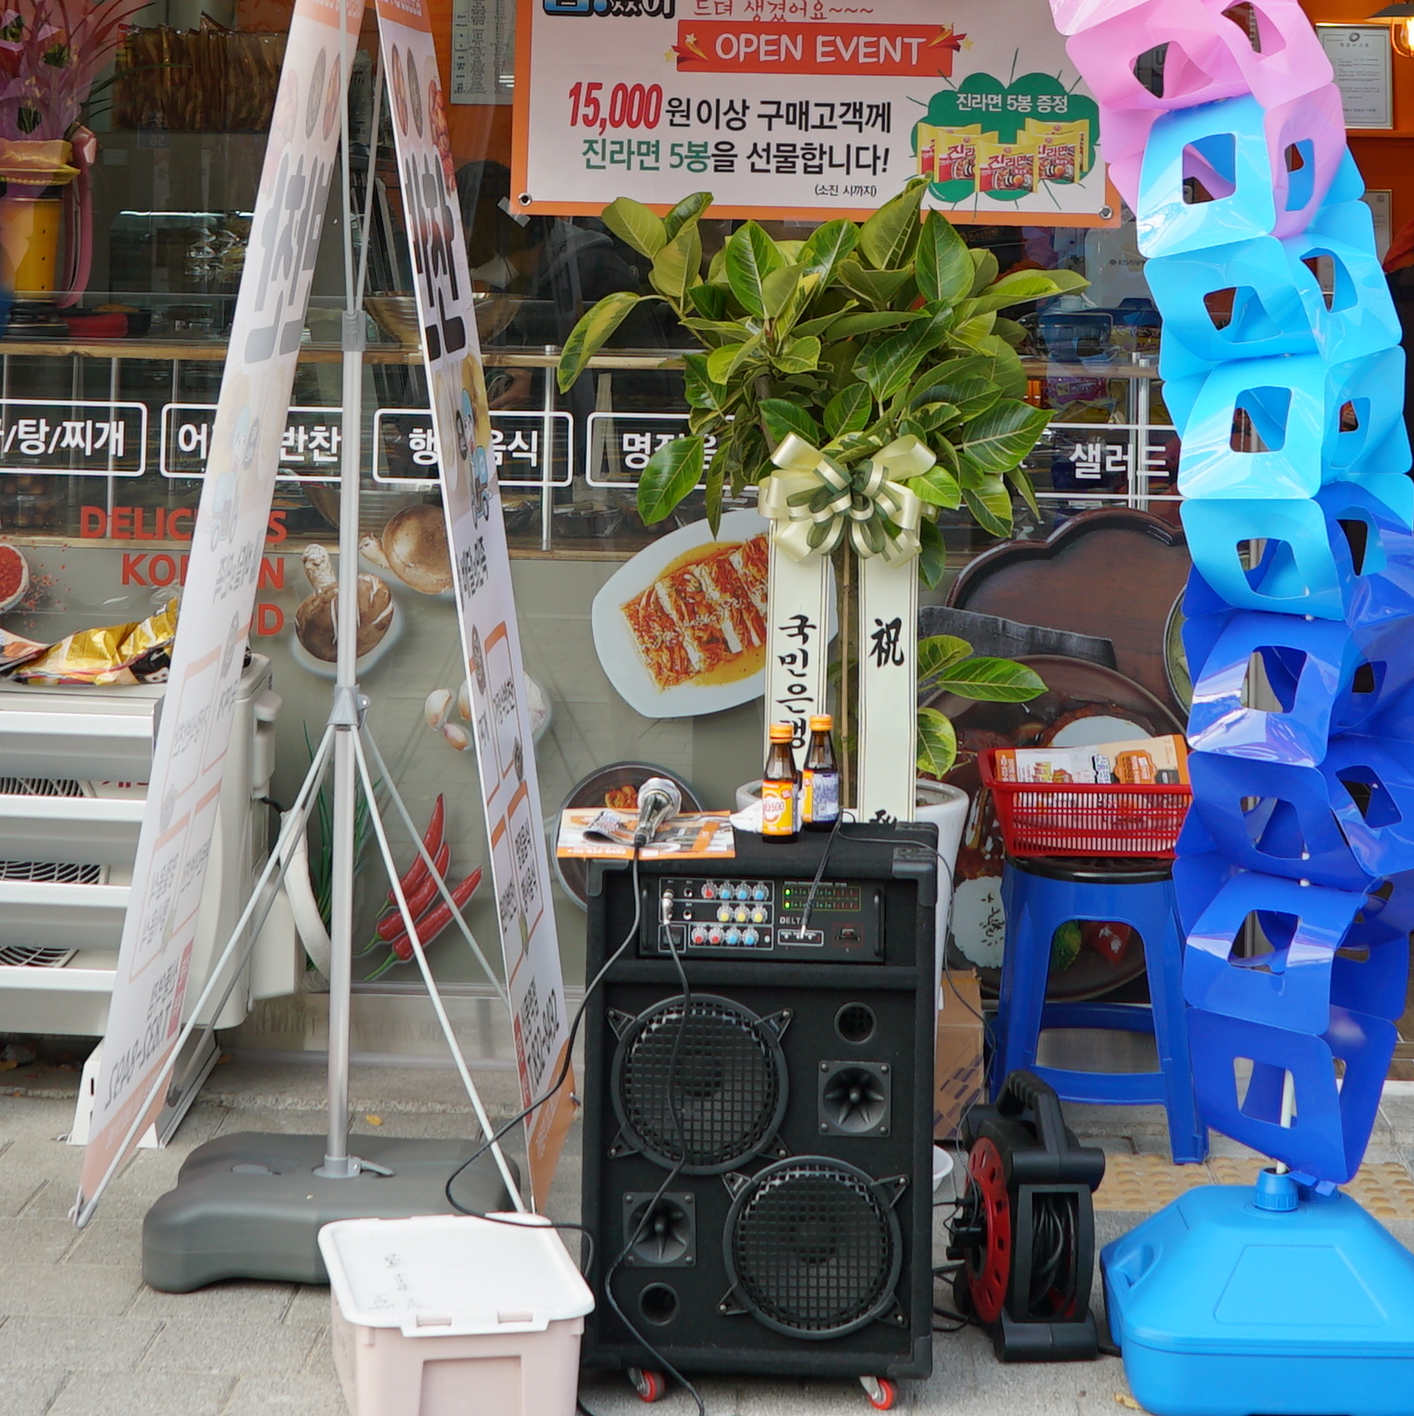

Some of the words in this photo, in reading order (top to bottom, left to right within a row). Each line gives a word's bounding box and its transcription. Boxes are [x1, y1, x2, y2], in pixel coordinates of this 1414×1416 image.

[715, 32, 802, 64] OPEN
[815, 35, 927, 66] EVENT
[569, 82, 662, 135] 15,000
[757, 99, 892, 134] 구매고객께
[956, 93, 1003, 112] 진라면
[1007, 94, 1032, 113] 5봉
[1037, 95, 1069, 114] 증정
[582, 138, 661, 173] 진라면
[668, 140, 736, 173] 5봉을
[746, 141, 890, 177] 선물합니다!
[1068, 442, 1169, 479] 샐러드
[868, 616, 905, 669] 祝
